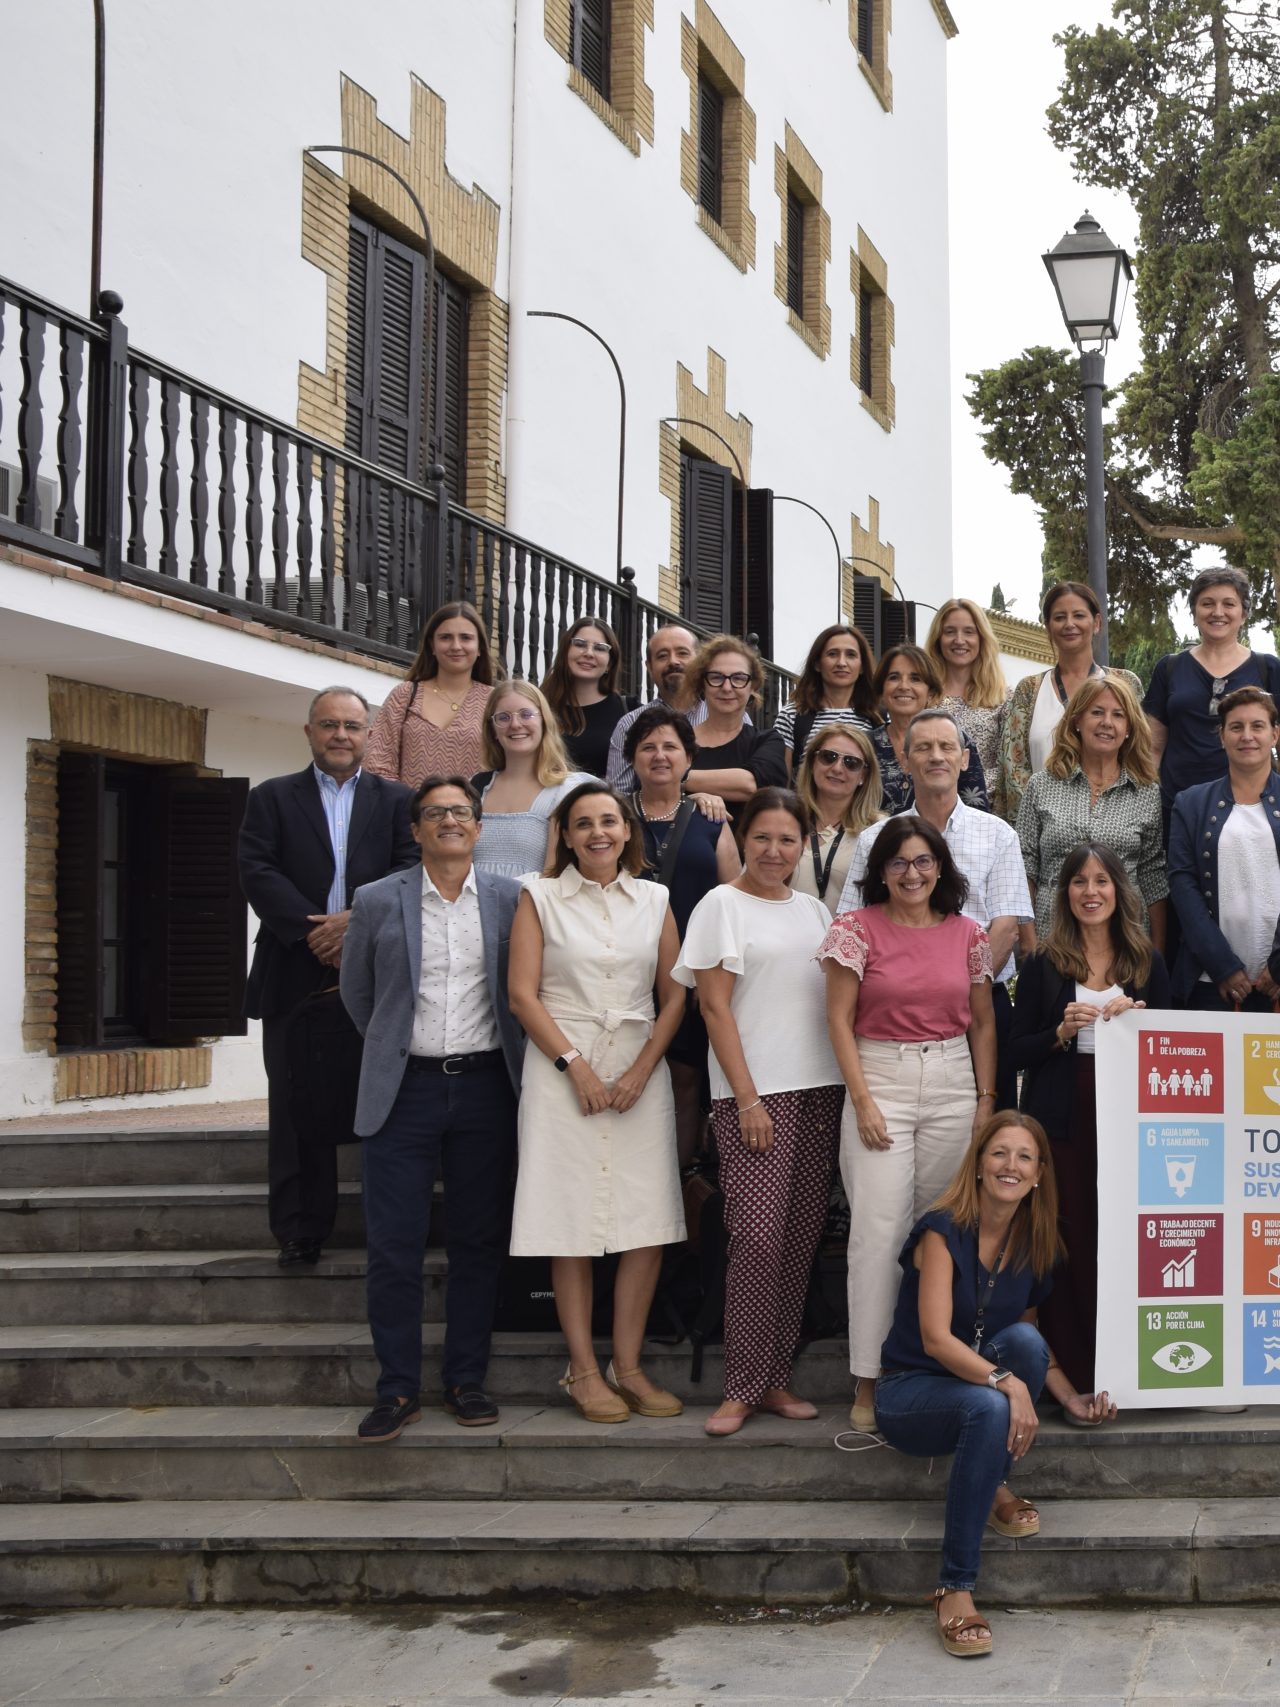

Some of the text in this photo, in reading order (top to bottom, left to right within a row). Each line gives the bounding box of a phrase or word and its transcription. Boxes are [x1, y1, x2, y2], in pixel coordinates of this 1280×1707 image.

[1147, 1036, 1153, 1054] 1
[1160, 1037, 1170, 1045] FIN
[1160, 1047, 1206, 1056] DE LA POBREZA
[1251, 1040, 1261, 1058] 2
[1161, 1128, 1199, 1136] AGUA LIMPIA
[1147, 1129, 1156, 1146] 6
[1162, 1138, 1209, 1146] Y SANEAMIENTO
[1160, 1220, 1216, 1228] TRABAJO DECENTE
[1252, 1219, 1261, 1237] 9
[1147, 1220, 1156, 1238] 8
[1160, 1229, 1205, 1237] Y CRECIMIENTO
[1160, 1238, 1196, 1247] ECONÓMICO
[1166, 1311, 1188, 1320] ACCIÓN
[1251, 1310, 1267, 1327] 14
[1146, 1312, 1161, 1330] 13
[1179, 1321, 1186, 1329] EL
[1186, 1321, 1205, 1329] CLIMA
